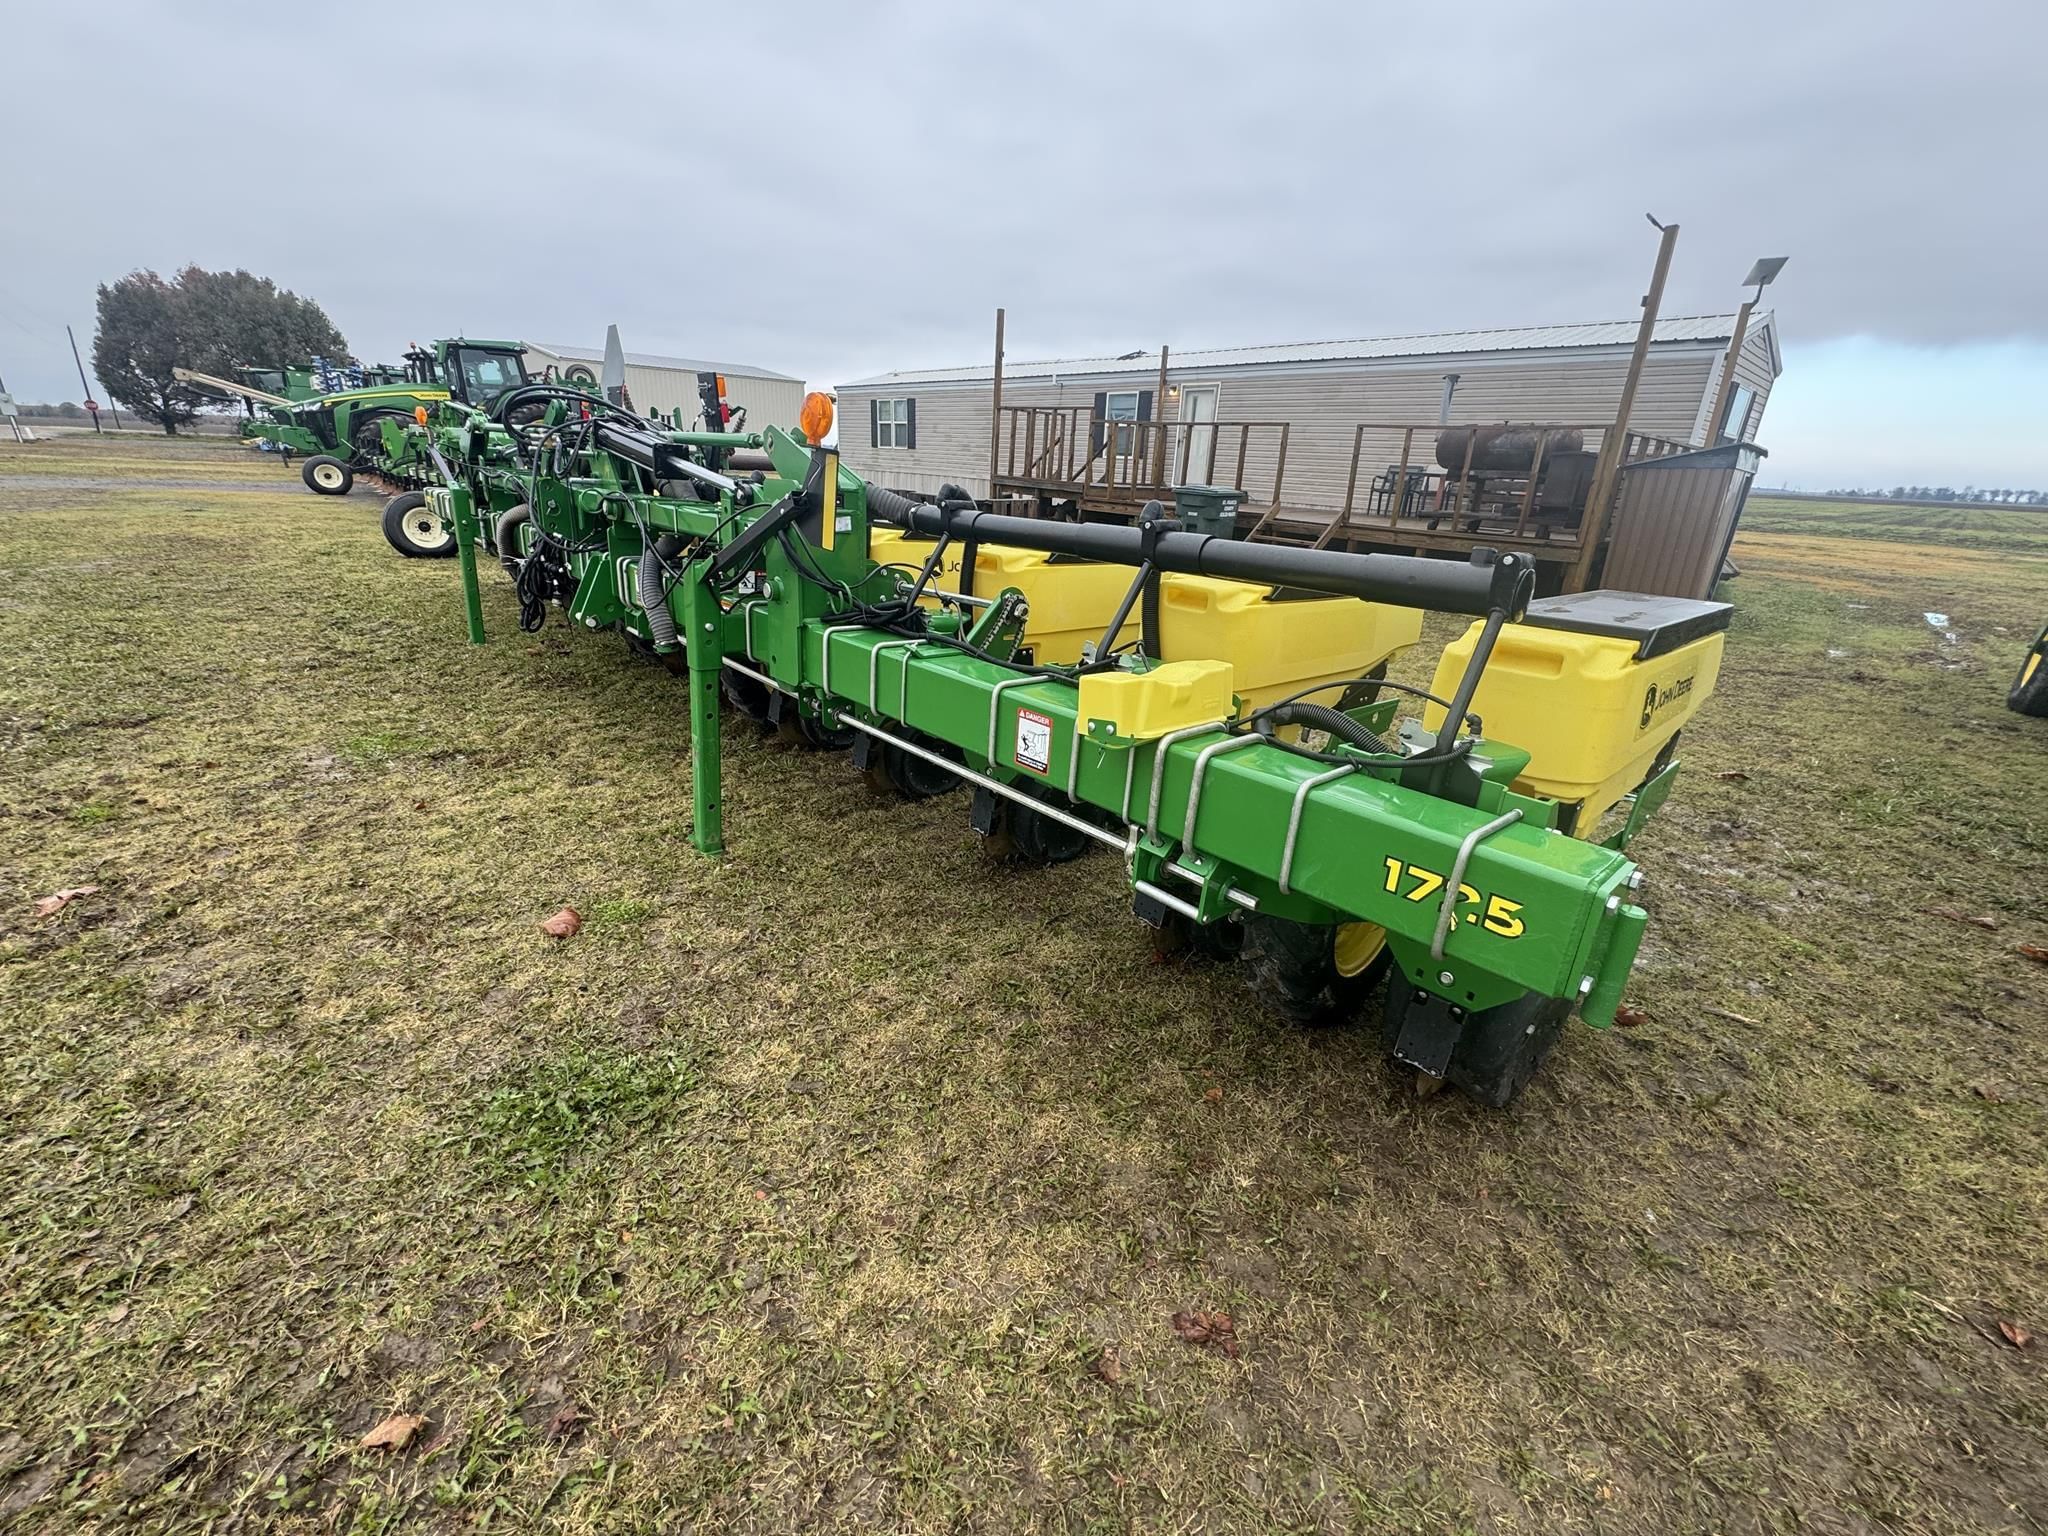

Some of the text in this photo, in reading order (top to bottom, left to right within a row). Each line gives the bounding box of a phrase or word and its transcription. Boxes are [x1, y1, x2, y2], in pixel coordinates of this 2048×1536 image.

[947, 560, 961, 572] JO
[1655, 676, 1694, 711] JOHN DEERE
[1025, 711, 1050, 726] DANGER
